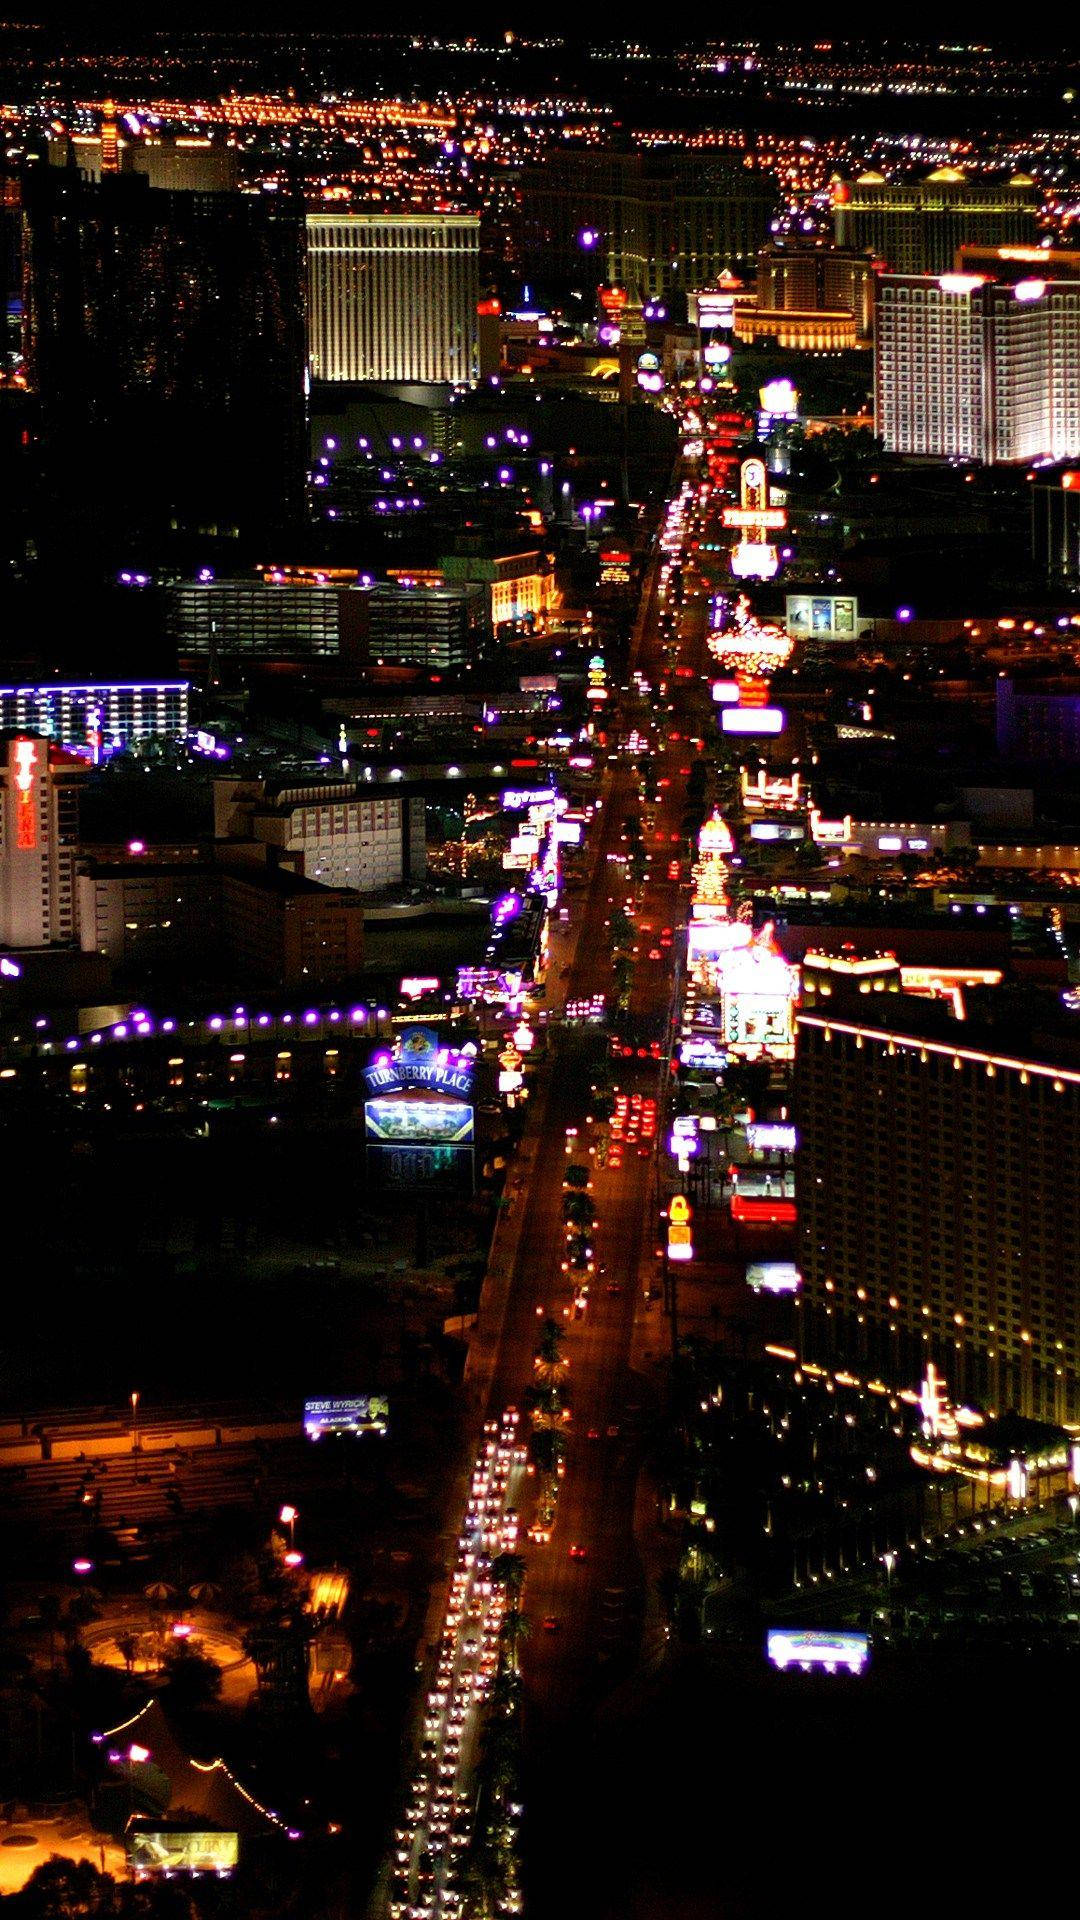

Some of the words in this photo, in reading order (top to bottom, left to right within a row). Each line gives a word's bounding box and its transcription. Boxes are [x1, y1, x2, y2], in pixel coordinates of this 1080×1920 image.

[366, 1065, 435, 1087] TURNBERRY
[435, 1067, 473, 1092] PLACE
[304, 1401, 331, 1411] STEVE
